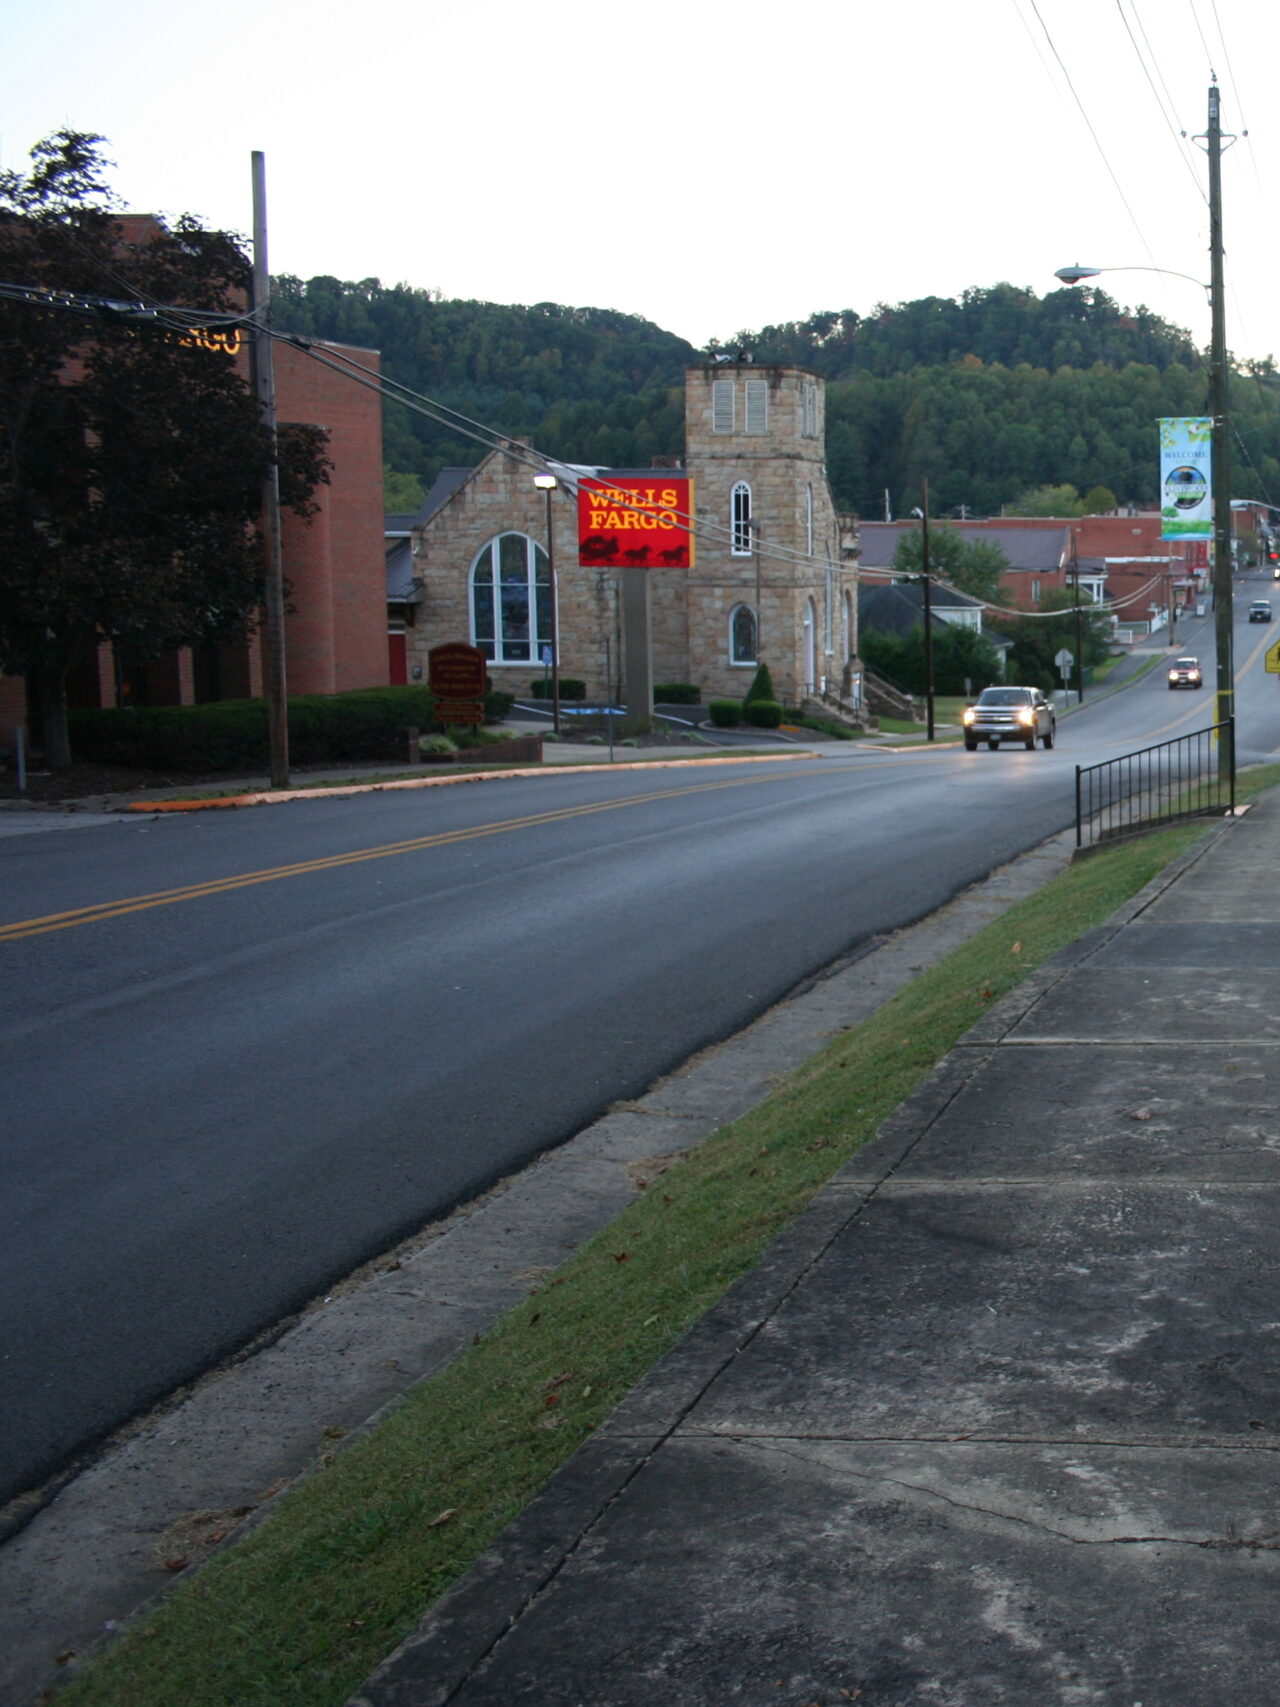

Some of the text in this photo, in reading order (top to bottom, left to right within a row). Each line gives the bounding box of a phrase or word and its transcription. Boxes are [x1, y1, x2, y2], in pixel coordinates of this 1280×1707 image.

[1164, 451, 1207, 459] WELCOME
[588, 489, 678, 508] WELLS
[589, 511, 677, 530] FARGO
